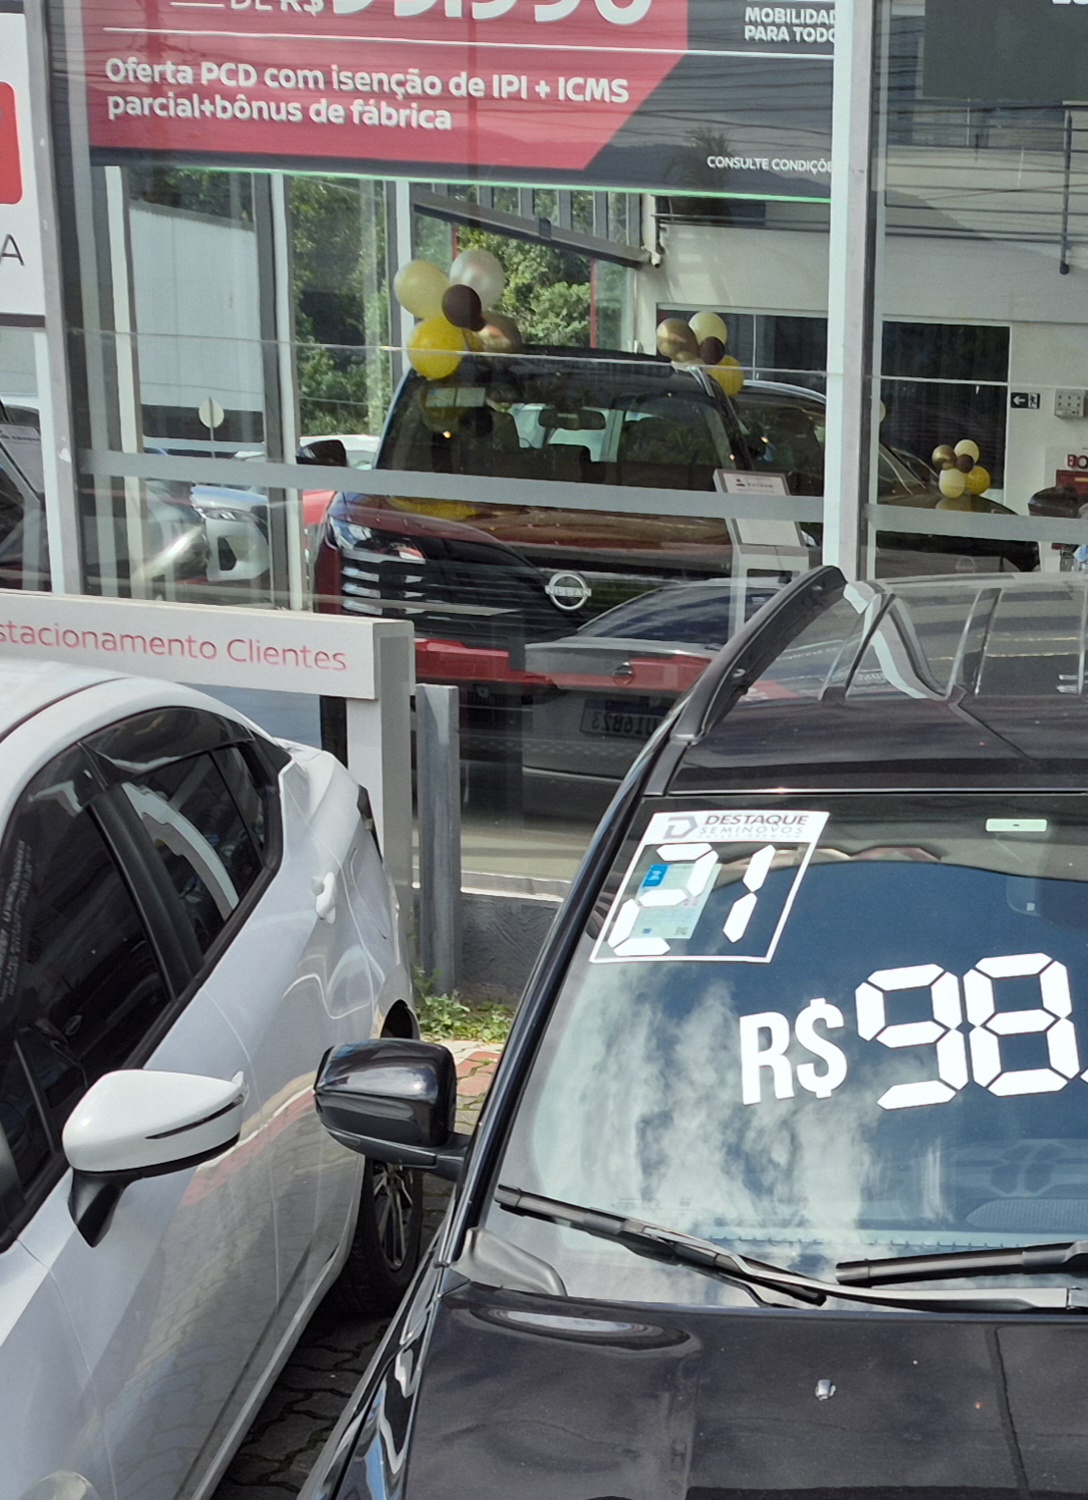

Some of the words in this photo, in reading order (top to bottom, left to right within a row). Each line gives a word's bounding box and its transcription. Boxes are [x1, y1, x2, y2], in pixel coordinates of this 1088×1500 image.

[744, 25, 790, 42] PARA
[105, 57, 194, 85] Oferta
[200, 62, 258, 88] PCD
[264, 67, 325, 90] com
[331, 64, 443, 100] isenção
[449, 71, 486, 99] de
[492, 74, 528, 99] IPI
[535, 80, 551, 98] +
[558, 77, 629, 103] ICMS
[107, 91, 304, 122] parcial+bônus
[309, 97, 346, 124] de
[350, 98, 453, 130] fábrica
[706, 156, 769, 170] CONSULTE
[544, 585, 592, 598] NISSAN
[226, 638, 348, 672] Clientes
[699, 826, 803, 835] SEMINOVOS
[704, 814, 809, 826] DESTAQUE
[608, 843, 776, 957] 21
[739, 997, 848, 1104] R$
